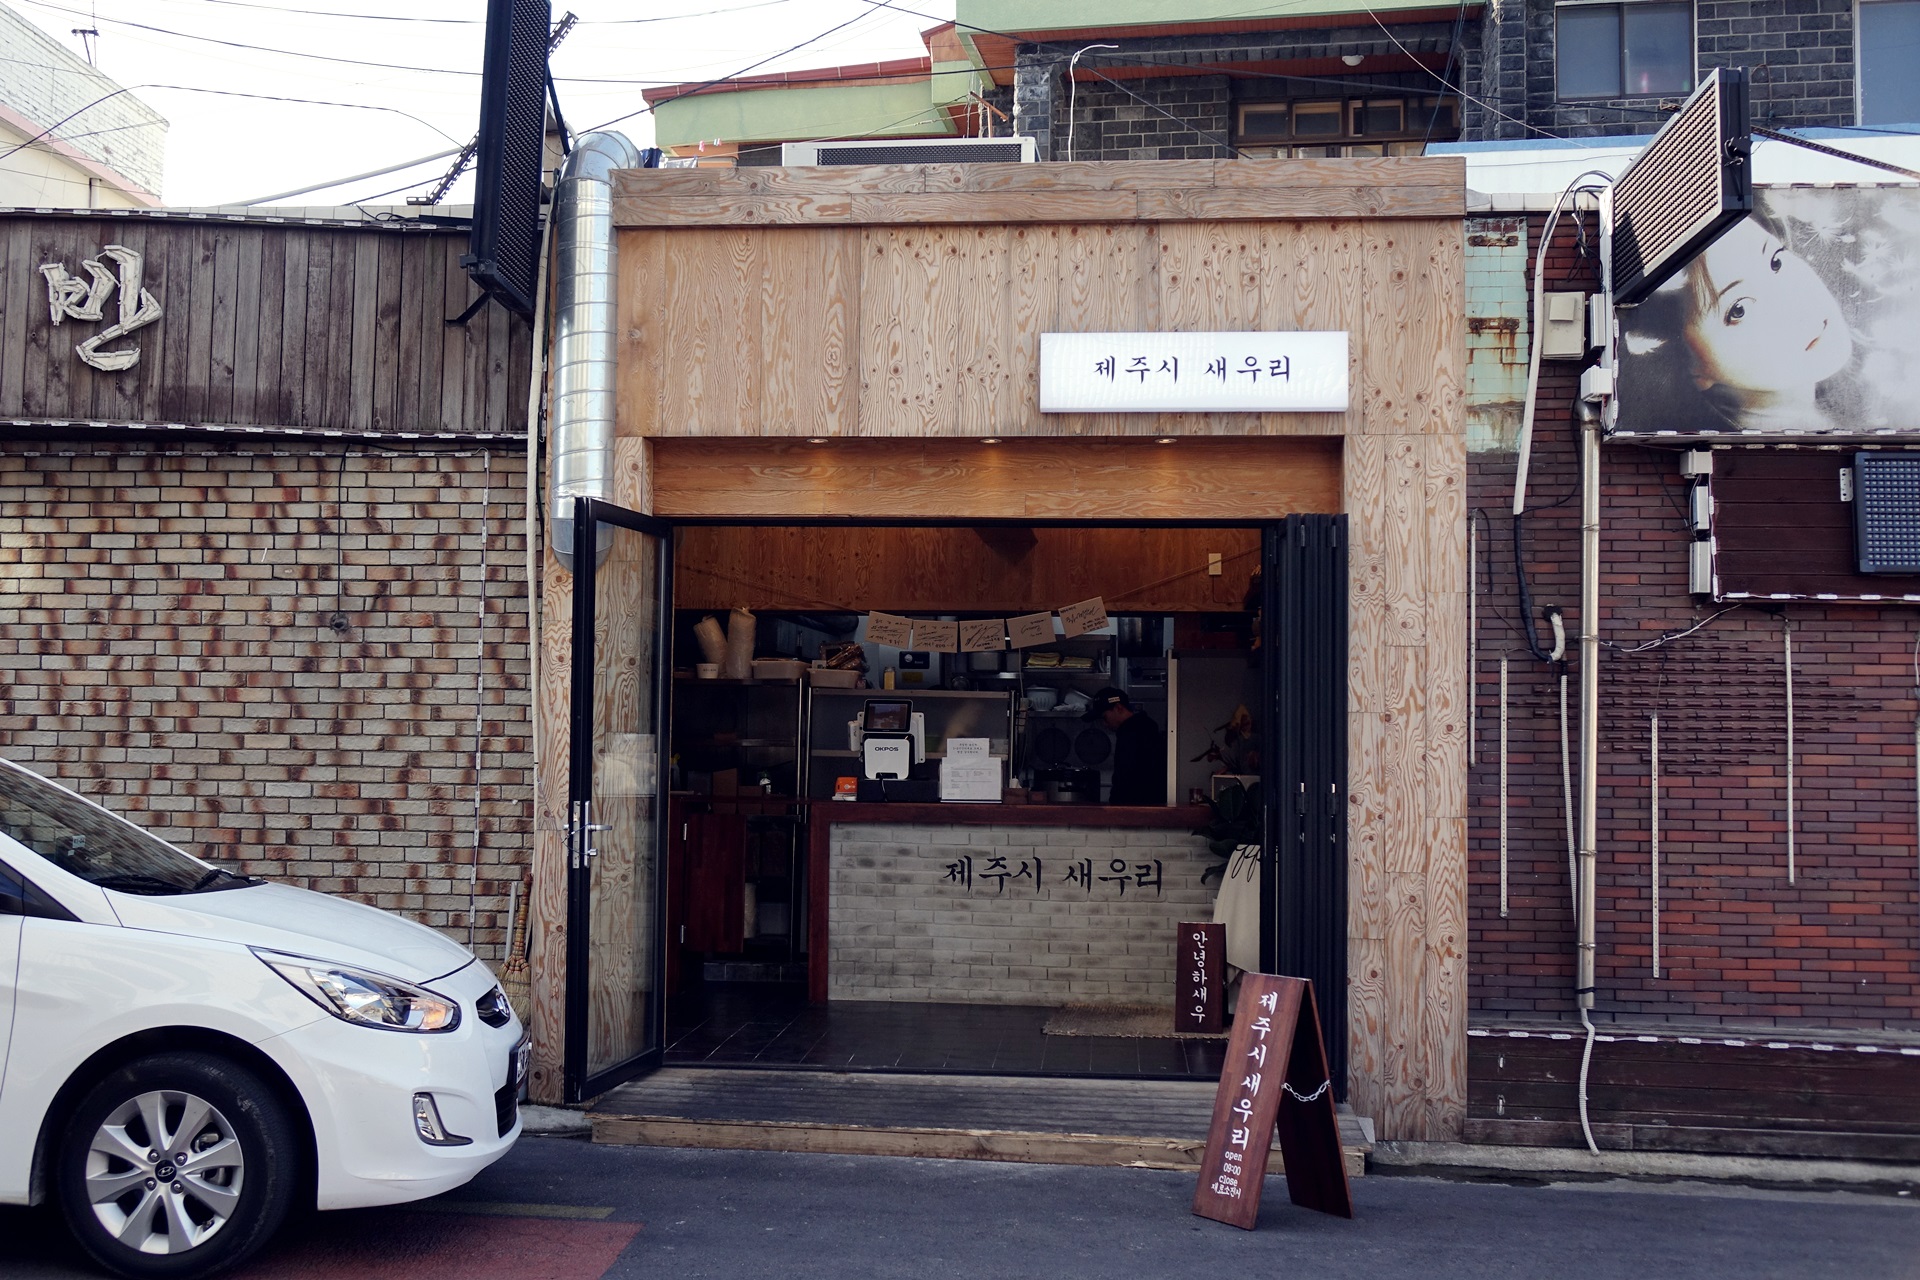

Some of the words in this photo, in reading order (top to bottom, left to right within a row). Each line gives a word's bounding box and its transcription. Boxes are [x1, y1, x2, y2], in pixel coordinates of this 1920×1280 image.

[1094, 355, 1180, 384] 제주시
[1203, 355, 1291, 384] 새우리
[943, 855, 1042, 894] 제주시
[1063, 857, 1163, 897] 새우리
[1190, 930, 1208, 1023] 안녕하새우
[1223, 1162, 1242, 1176] 09:00
[1224, 1151, 1243, 1162] open
